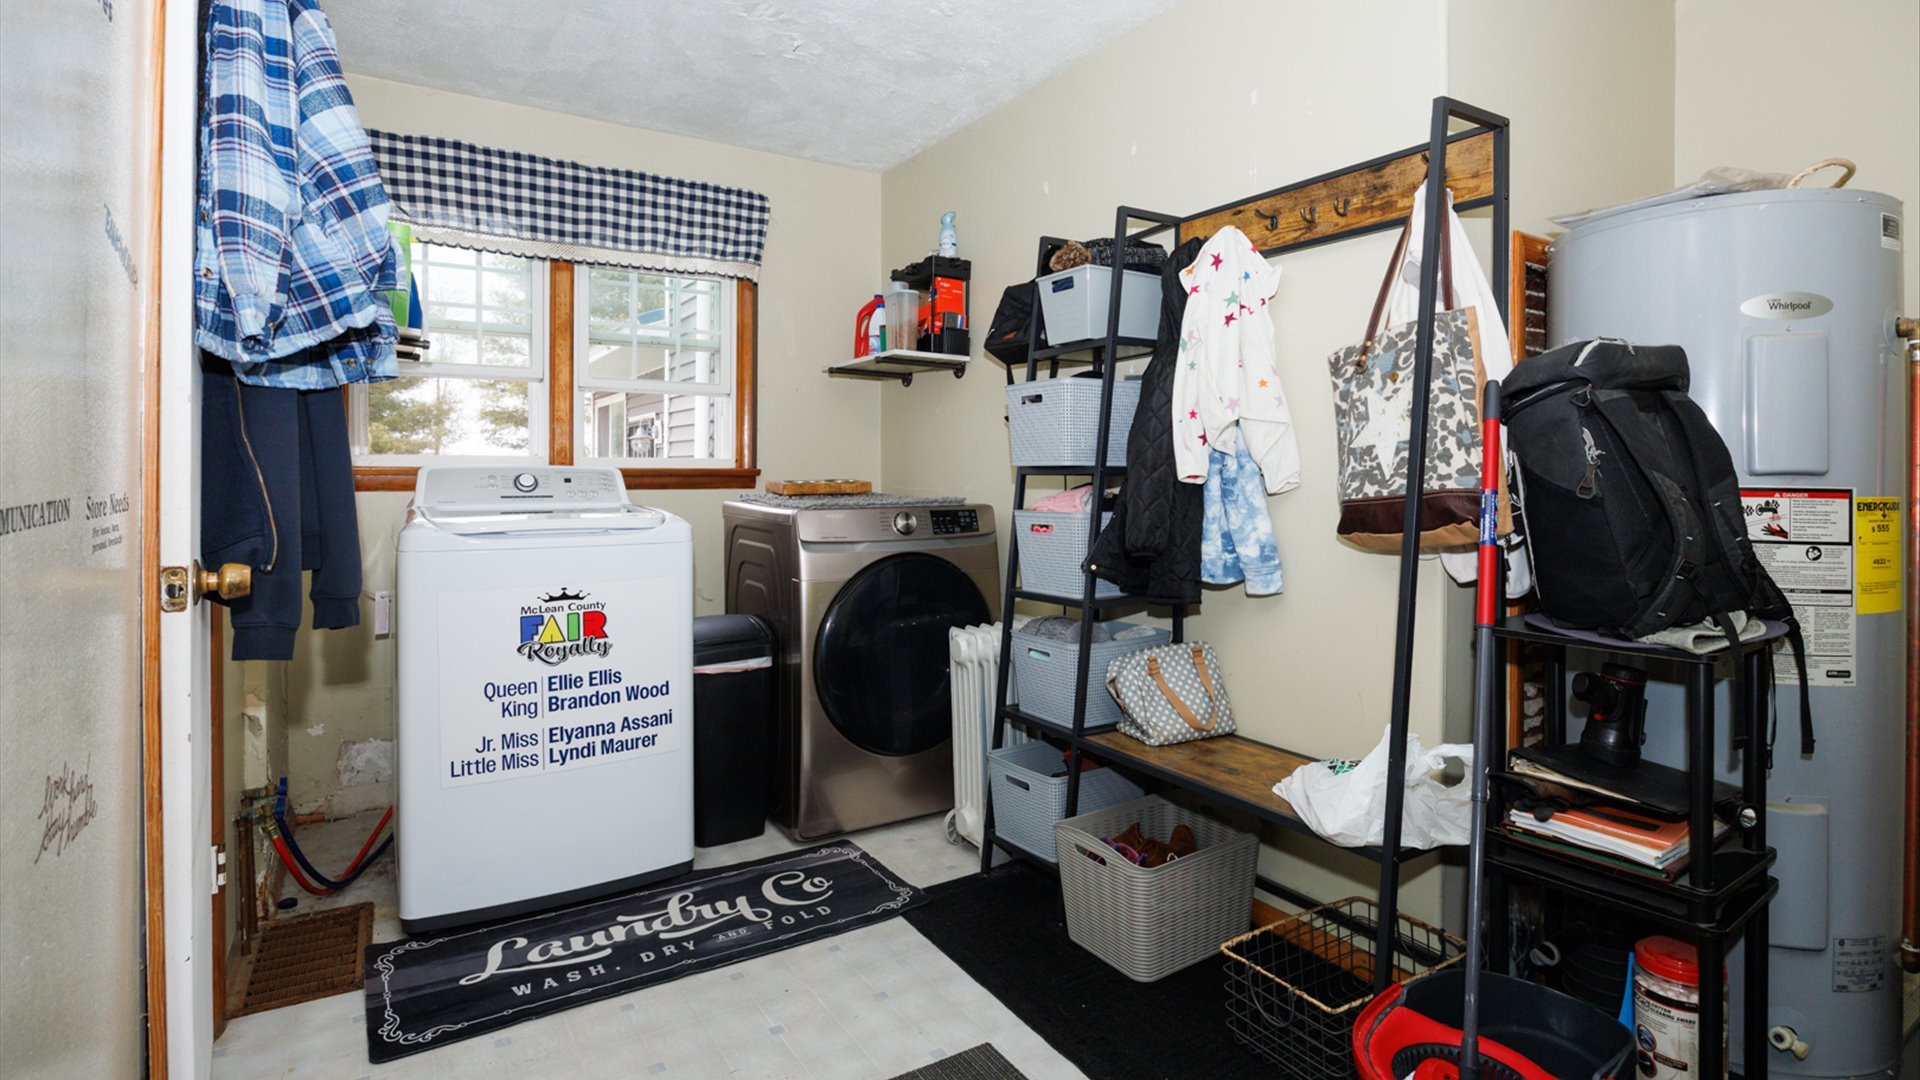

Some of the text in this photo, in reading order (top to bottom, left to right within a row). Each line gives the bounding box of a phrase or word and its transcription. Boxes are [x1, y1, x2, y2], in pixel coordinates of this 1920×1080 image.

[1768, 301, 1812, 312] Whirlpool
[85, 492, 130, 520] Store Needs
[1877, 524, 1890, 533] 555
[520, 601, 606, 615] McLean County
[520, 610, 608, 644] FAIR
[516, 635, 613, 667] Royalty
[484, 680, 538, 702] Queen
[548, 668, 622, 692] Ellie Ellis
[548, 680, 669, 712] Brandon Wood
[501, 701, 538, 719] King
[549, 709, 673, 745] Elyanna Assani
[475, 732, 539, 753] Jr. Miss
[549, 733, 658, 766] Lyndi Maurer
[450, 753, 539, 778] Little Miss
[458, 871, 833, 986] Laundry Co
[639, 940, 696, 963] DRY
[717, 927, 748, 941] AND
[762, 905, 832, 930] FOLD
